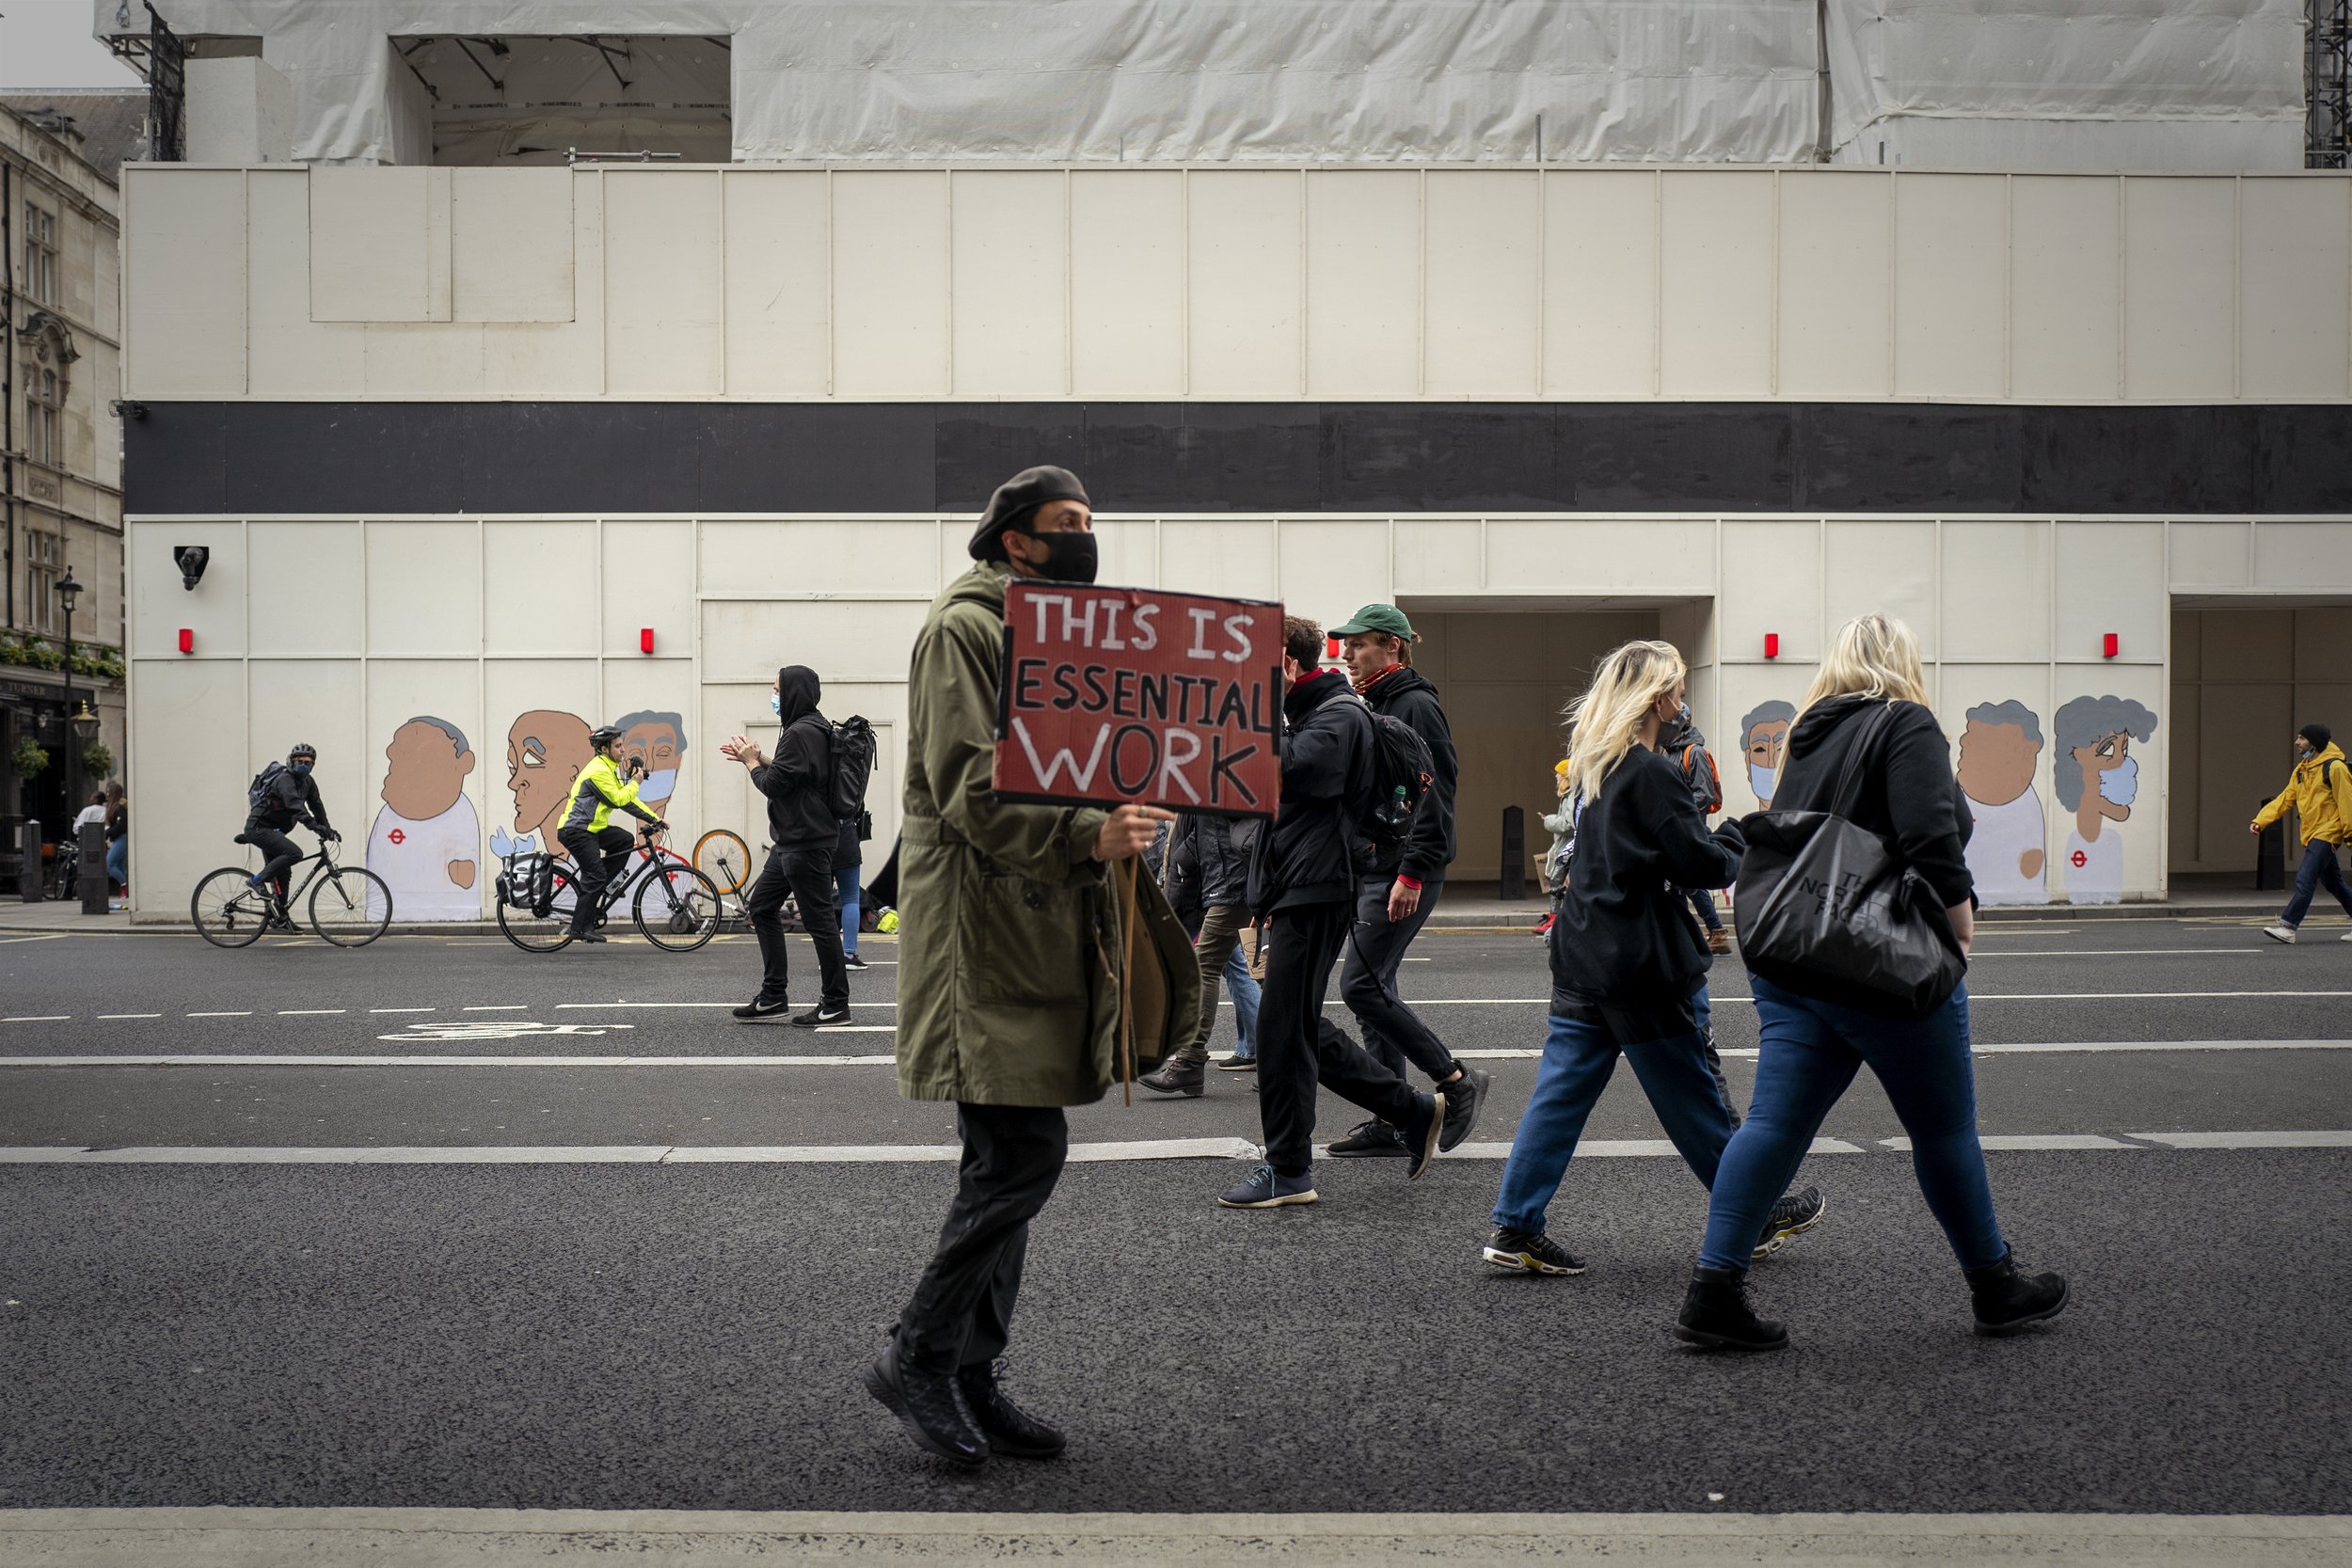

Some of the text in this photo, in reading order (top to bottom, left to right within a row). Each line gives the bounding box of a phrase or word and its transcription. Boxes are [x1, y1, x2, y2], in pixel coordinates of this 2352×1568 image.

[1025, 593, 1254, 662] THIS IS
[8, 682, 46, 696] TURNER
[1014, 657, 1271, 734] ESSENTIAL
[1011, 717, 1258, 808] WORK
[1843, 871, 1865, 888] TH
